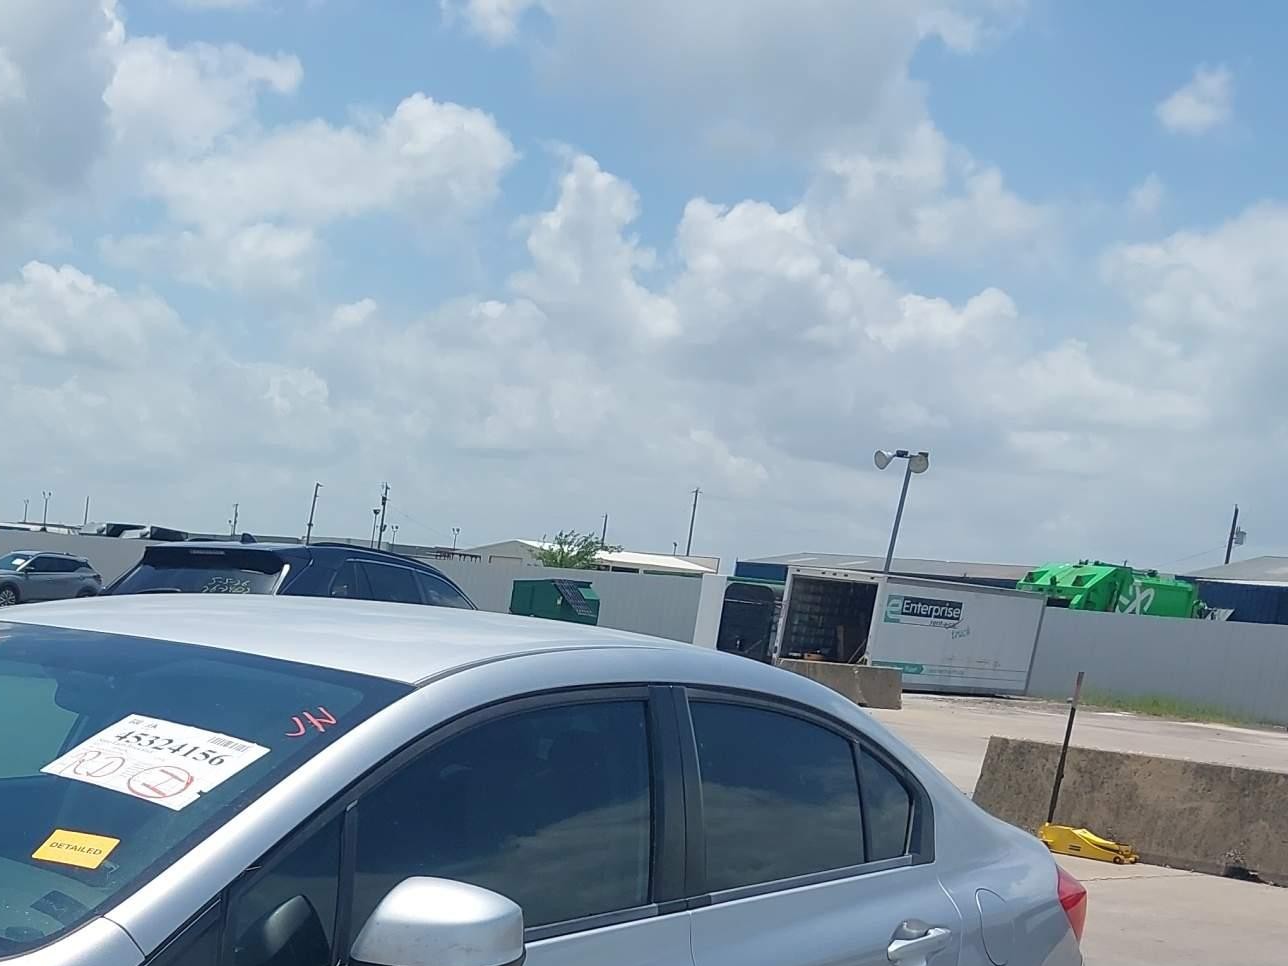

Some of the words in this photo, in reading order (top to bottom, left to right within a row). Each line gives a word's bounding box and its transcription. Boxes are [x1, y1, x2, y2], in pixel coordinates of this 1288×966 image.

[903, 600, 961, 618] Enterprise
[115, 731, 234, 766] 45324156
[49, 841, 103, 856] DETAILED
